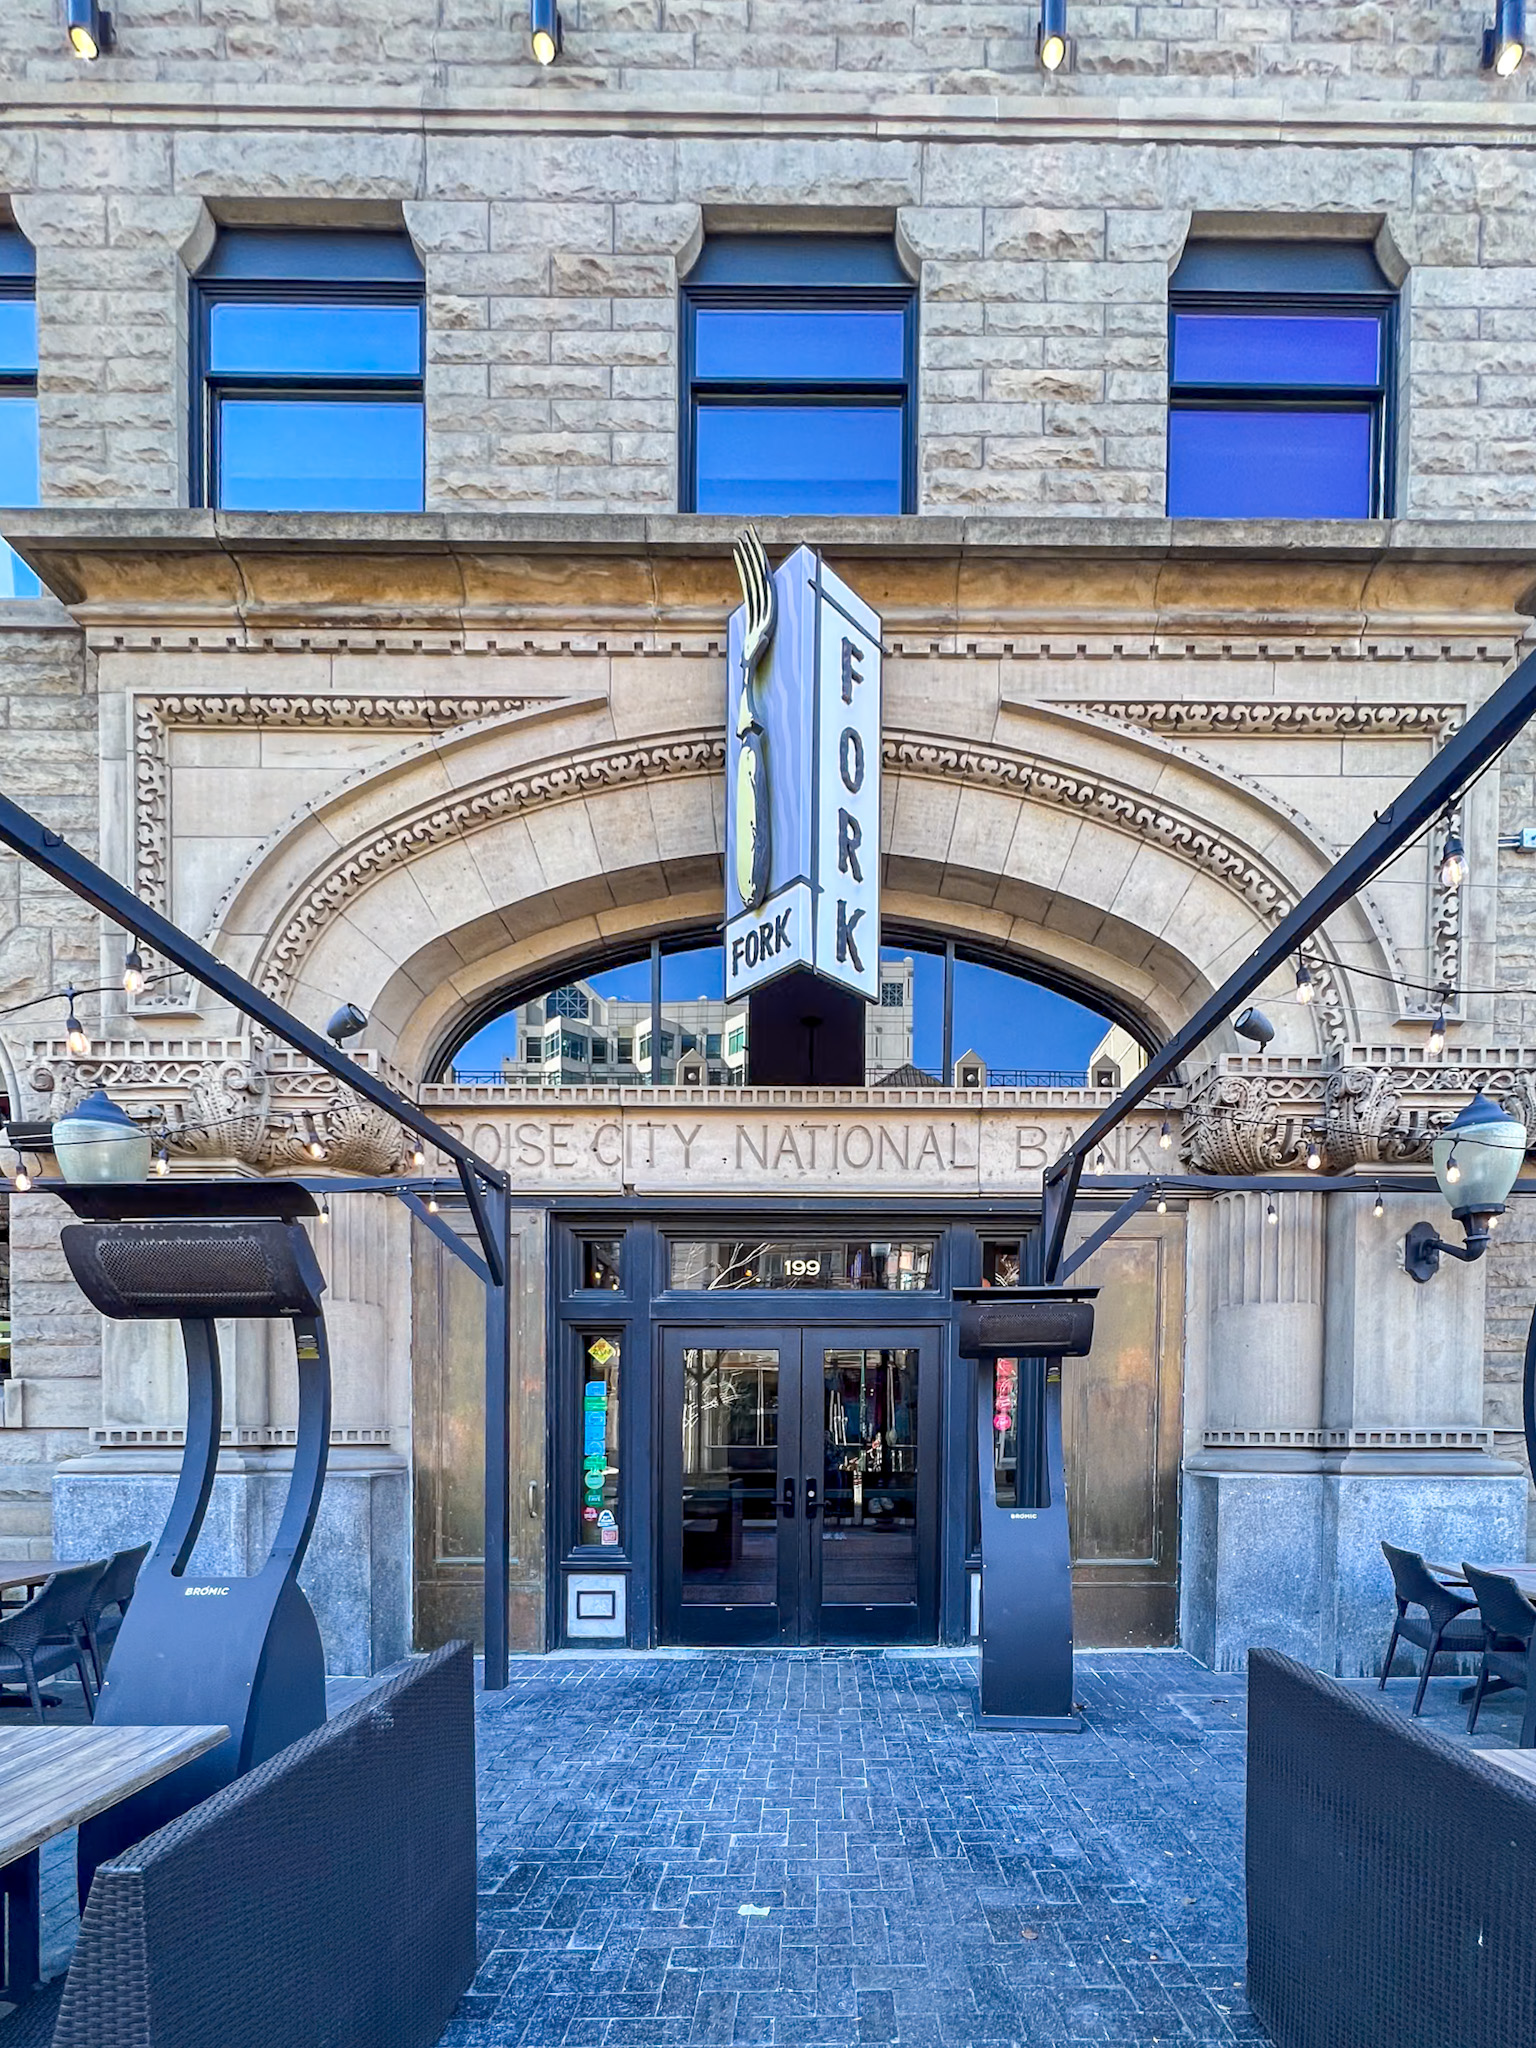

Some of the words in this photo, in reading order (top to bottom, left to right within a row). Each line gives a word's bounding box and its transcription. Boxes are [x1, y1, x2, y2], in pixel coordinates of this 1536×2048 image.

[836, 636, 867, 973] FORK
[731, 906, 792, 977] FORK
[590, 1123, 703, 1169] CITY
[735, 1123, 977, 1170] NATIONAL
[784, 1259, 821, 1276] 199
